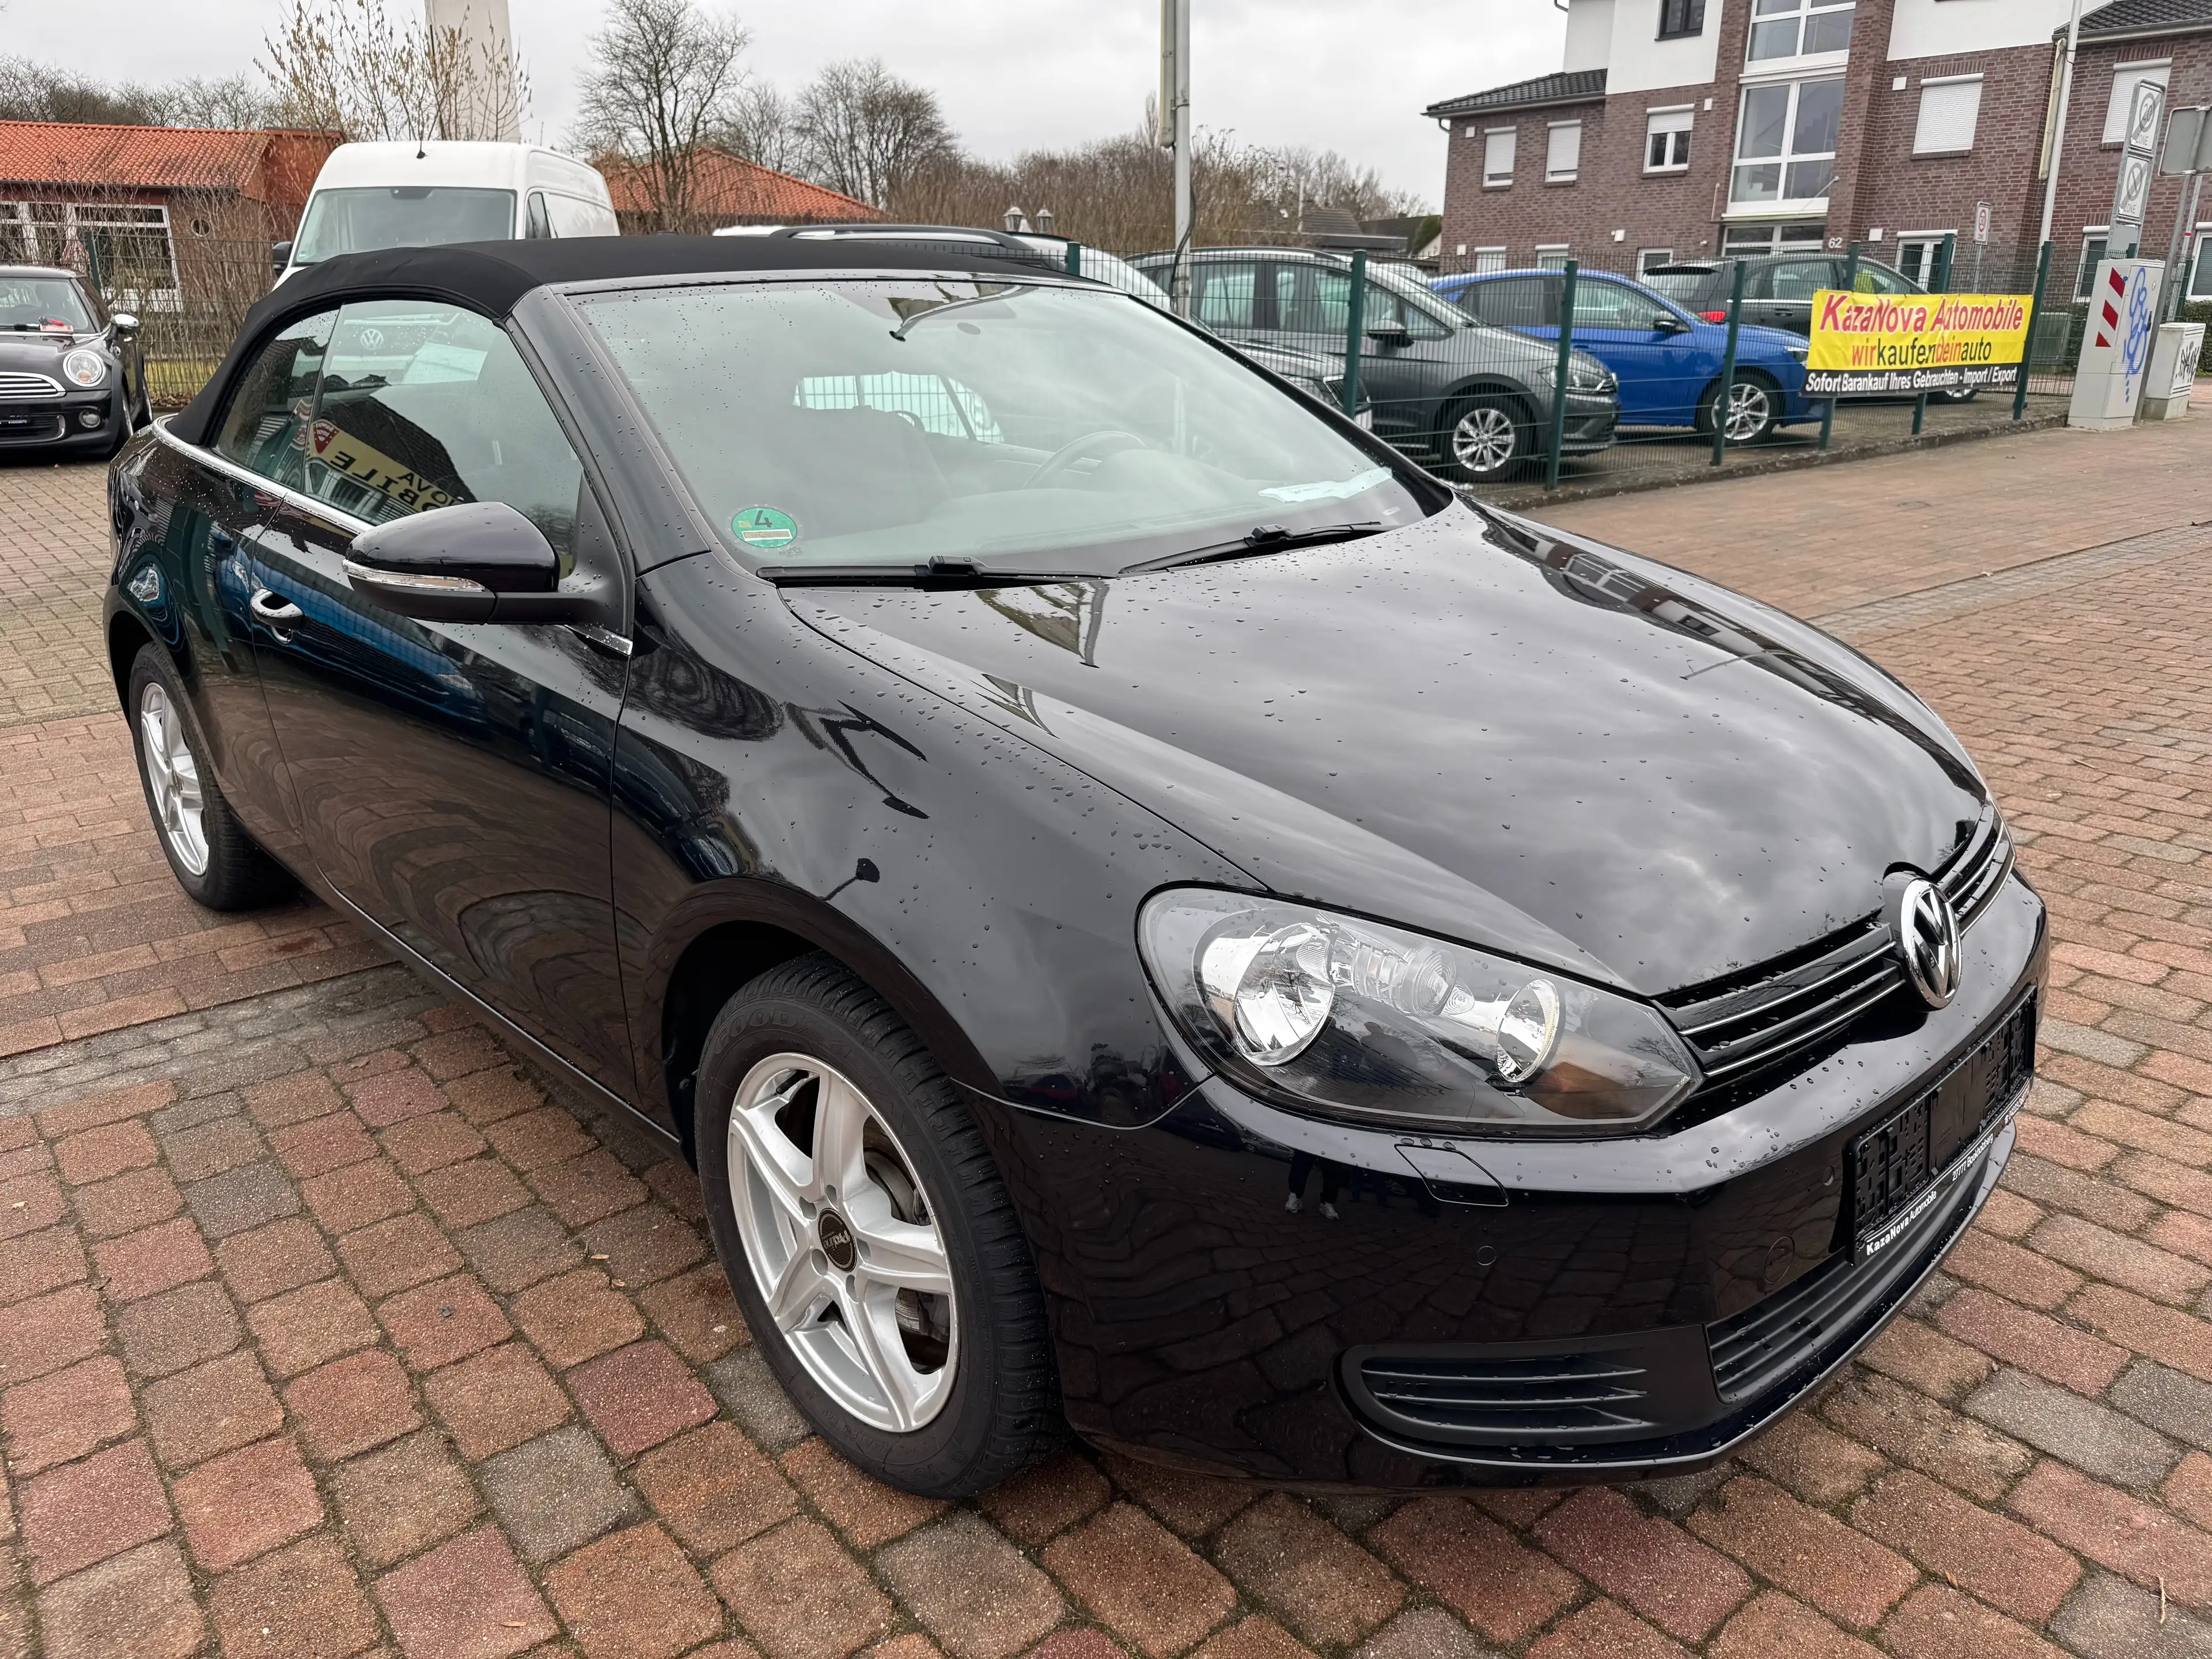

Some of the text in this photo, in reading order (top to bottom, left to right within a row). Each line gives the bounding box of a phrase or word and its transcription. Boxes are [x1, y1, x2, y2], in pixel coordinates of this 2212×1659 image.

[1828, 237, 1843, 248] 62
[1819, 294, 2024, 333] KazaNova Automobile
[1852, 336, 1992, 366] wirkaufendeinauto
[1805, 372, 1842, 392] Sofort
[1842, 372, 1889, 392] Barankauf
[1889, 372, 1911, 391] Ihres
[1913, 369, 1959, 389] Gebrauchten
[1963, 367, 1988, 388] Import
[1992, 366, 2017, 386] Export
[755, 510, 772, 527] 4
[1866, 1217, 1909, 1256] KazaNova
[1910, 1191, 1937, 1222] Automobile
